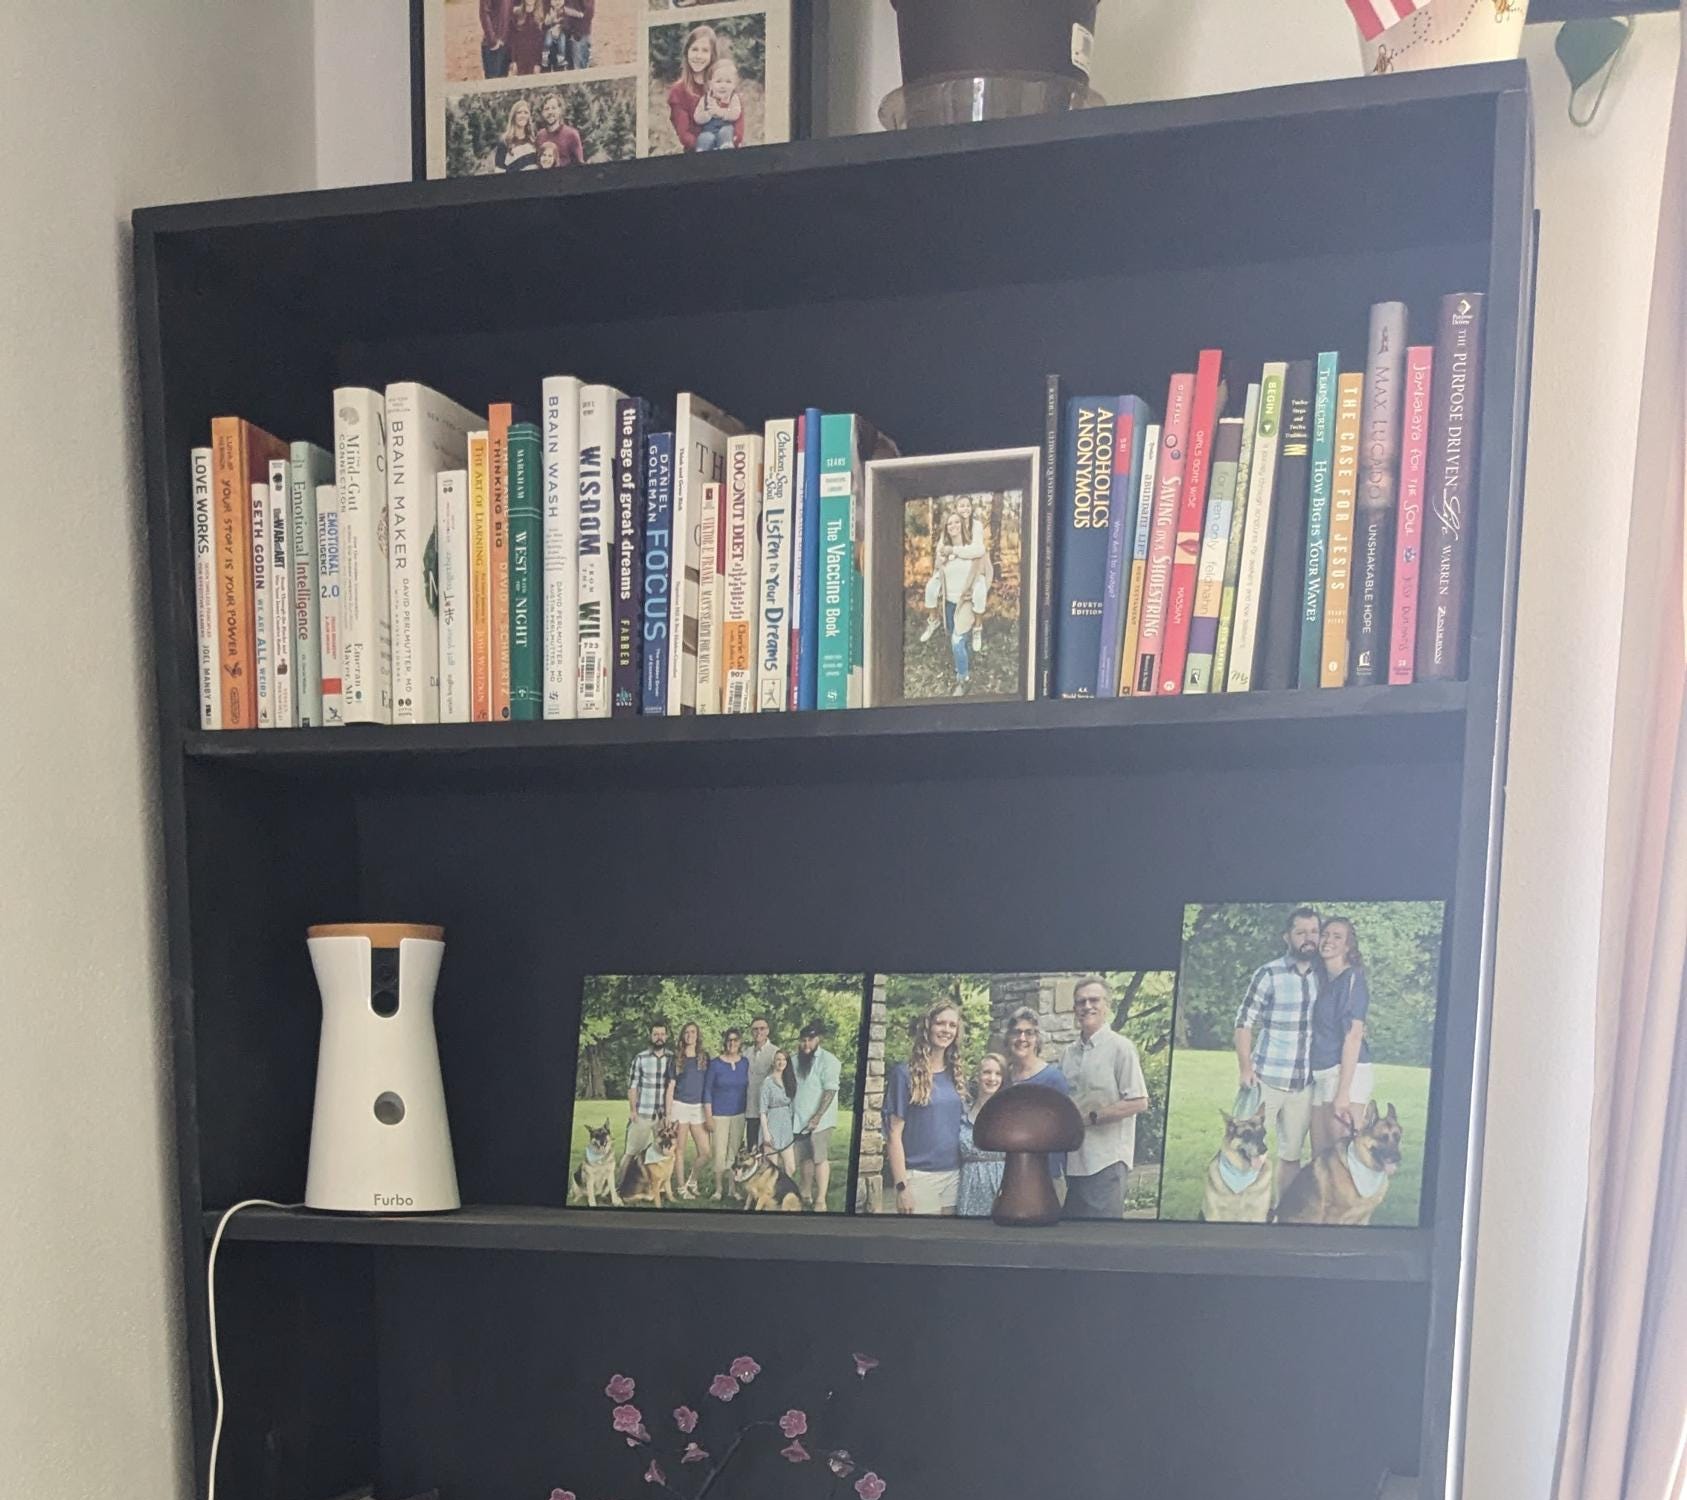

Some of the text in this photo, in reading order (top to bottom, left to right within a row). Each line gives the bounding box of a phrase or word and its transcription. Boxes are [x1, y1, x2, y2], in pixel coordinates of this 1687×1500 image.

[1265, 382, 1277, 414] BEGIN
[1341, 387, 1358, 419] THE
[391, 421, 403, 484] BRAIN
[548, 395, 559, 518] BRAIN WASH
[826, 458, 846, 467] SEARS
[1338, 432, 1354, 477] CASE
[1367, 366, 1391, 502] MAX LUCADO
[221, 480, 233, 512] YOUR
[339, 434, 347, 512] CONNECTION
[493, 439, 502, 515] THINKING
[516, 448, 526, 499] MARKHAM
[647, 444, 659, 522] GOLEMAN
[658, 453, 670, 513] DANIEL
[1072, 407, 1095, 528] ANONYMOUS
[1092, 407, 1114, 528] ALCOHOLICS
[579, 445, 601, 557] WISDOM
[618, 408, 637, 600] the age of great dreams
[827, 519, 842, 541] The
[1335, 489, 1351, 521] FOR
[223, 518, 234, 552] STORY
[253, 499, 265, 589] SETH GODIN
[292, 481, 310, 640] Emotional Intelligence
[318, 512, 328, 577] INTELLIGENCE
[328, 512, 340, 576] EMOTIONAL
[393, 496, 407, 570] MAKER
[515, 530, 528, 571] WEST
[1330, 533, 1347, 590] JESUS
[224, 558, 234, 569] IS
[225, 575, 236, 606] YOUR
[321, 585, 340, 599] 2.0
[643, 529, 669, 641] FOCUS
[764, 508, 785, 671] Listen to Your Dreams
[826, 543, 845, 604] Vaccine
[1361, 523, 1377, 634] UNSHAKABLE HOPE
[226, 610, 238, 656] POWER
[515, 597, 529, 646] NIGHT
[825, 608, 840, 637] Book
[1071, 608, 1103, 617] EDITION
[352, 643, 364, 687] Emeran
[374, 1194, 413, 1207] Furbo
